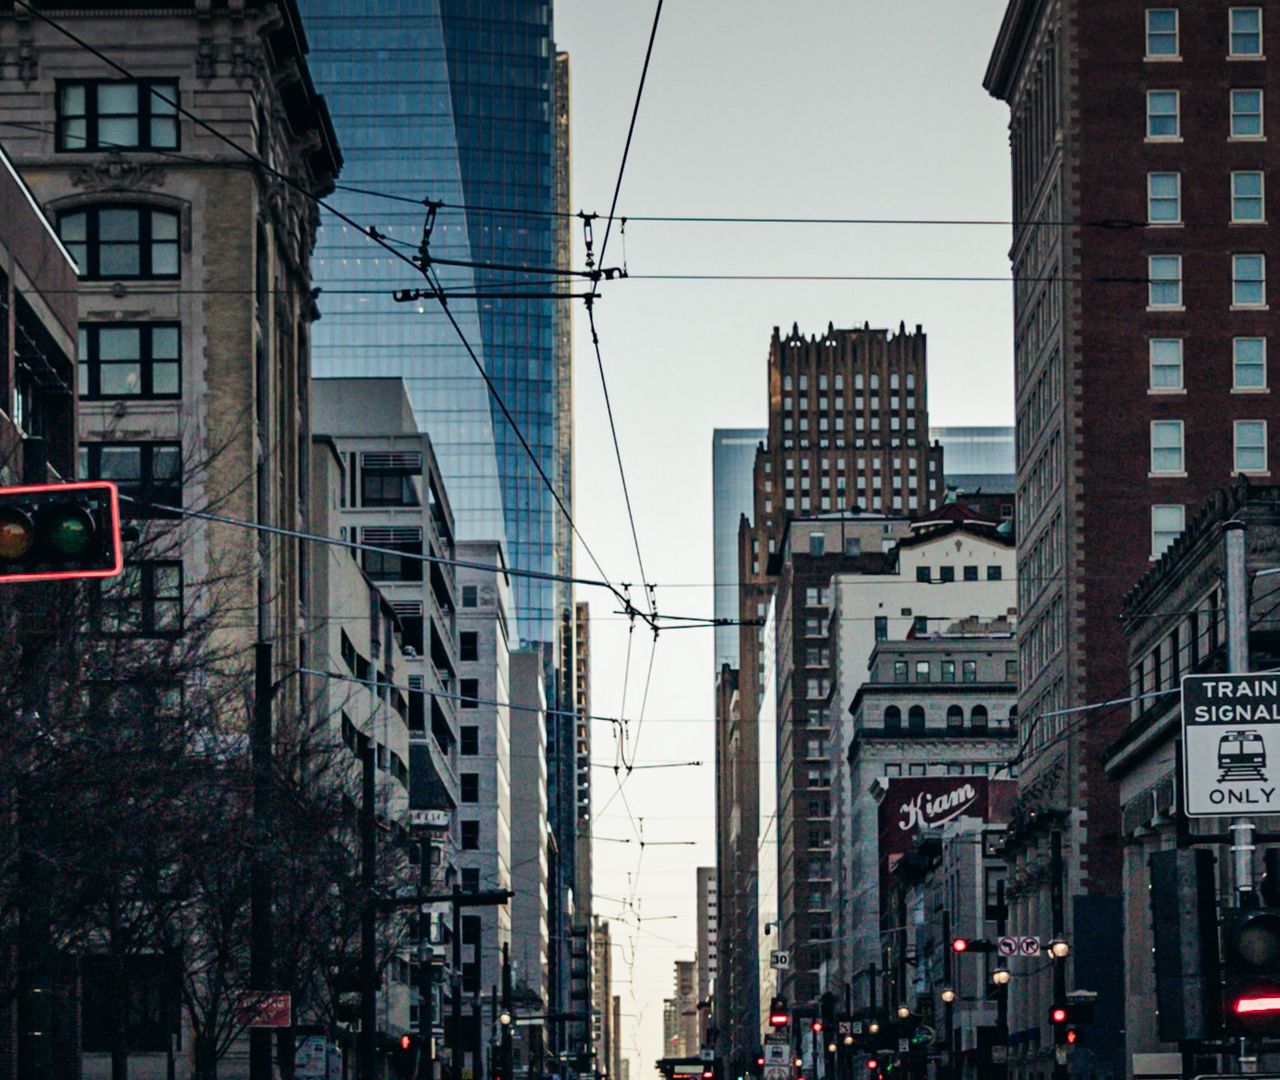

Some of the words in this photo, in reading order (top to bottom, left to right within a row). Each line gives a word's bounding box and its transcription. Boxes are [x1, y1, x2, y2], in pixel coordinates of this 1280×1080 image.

[1202, 680, 1278, 698] TRAIN
[1209, 787, 1276, 804] ONLY
[898, 783, 978, 831] Kiam
[773, 955, 787, 964] 30
